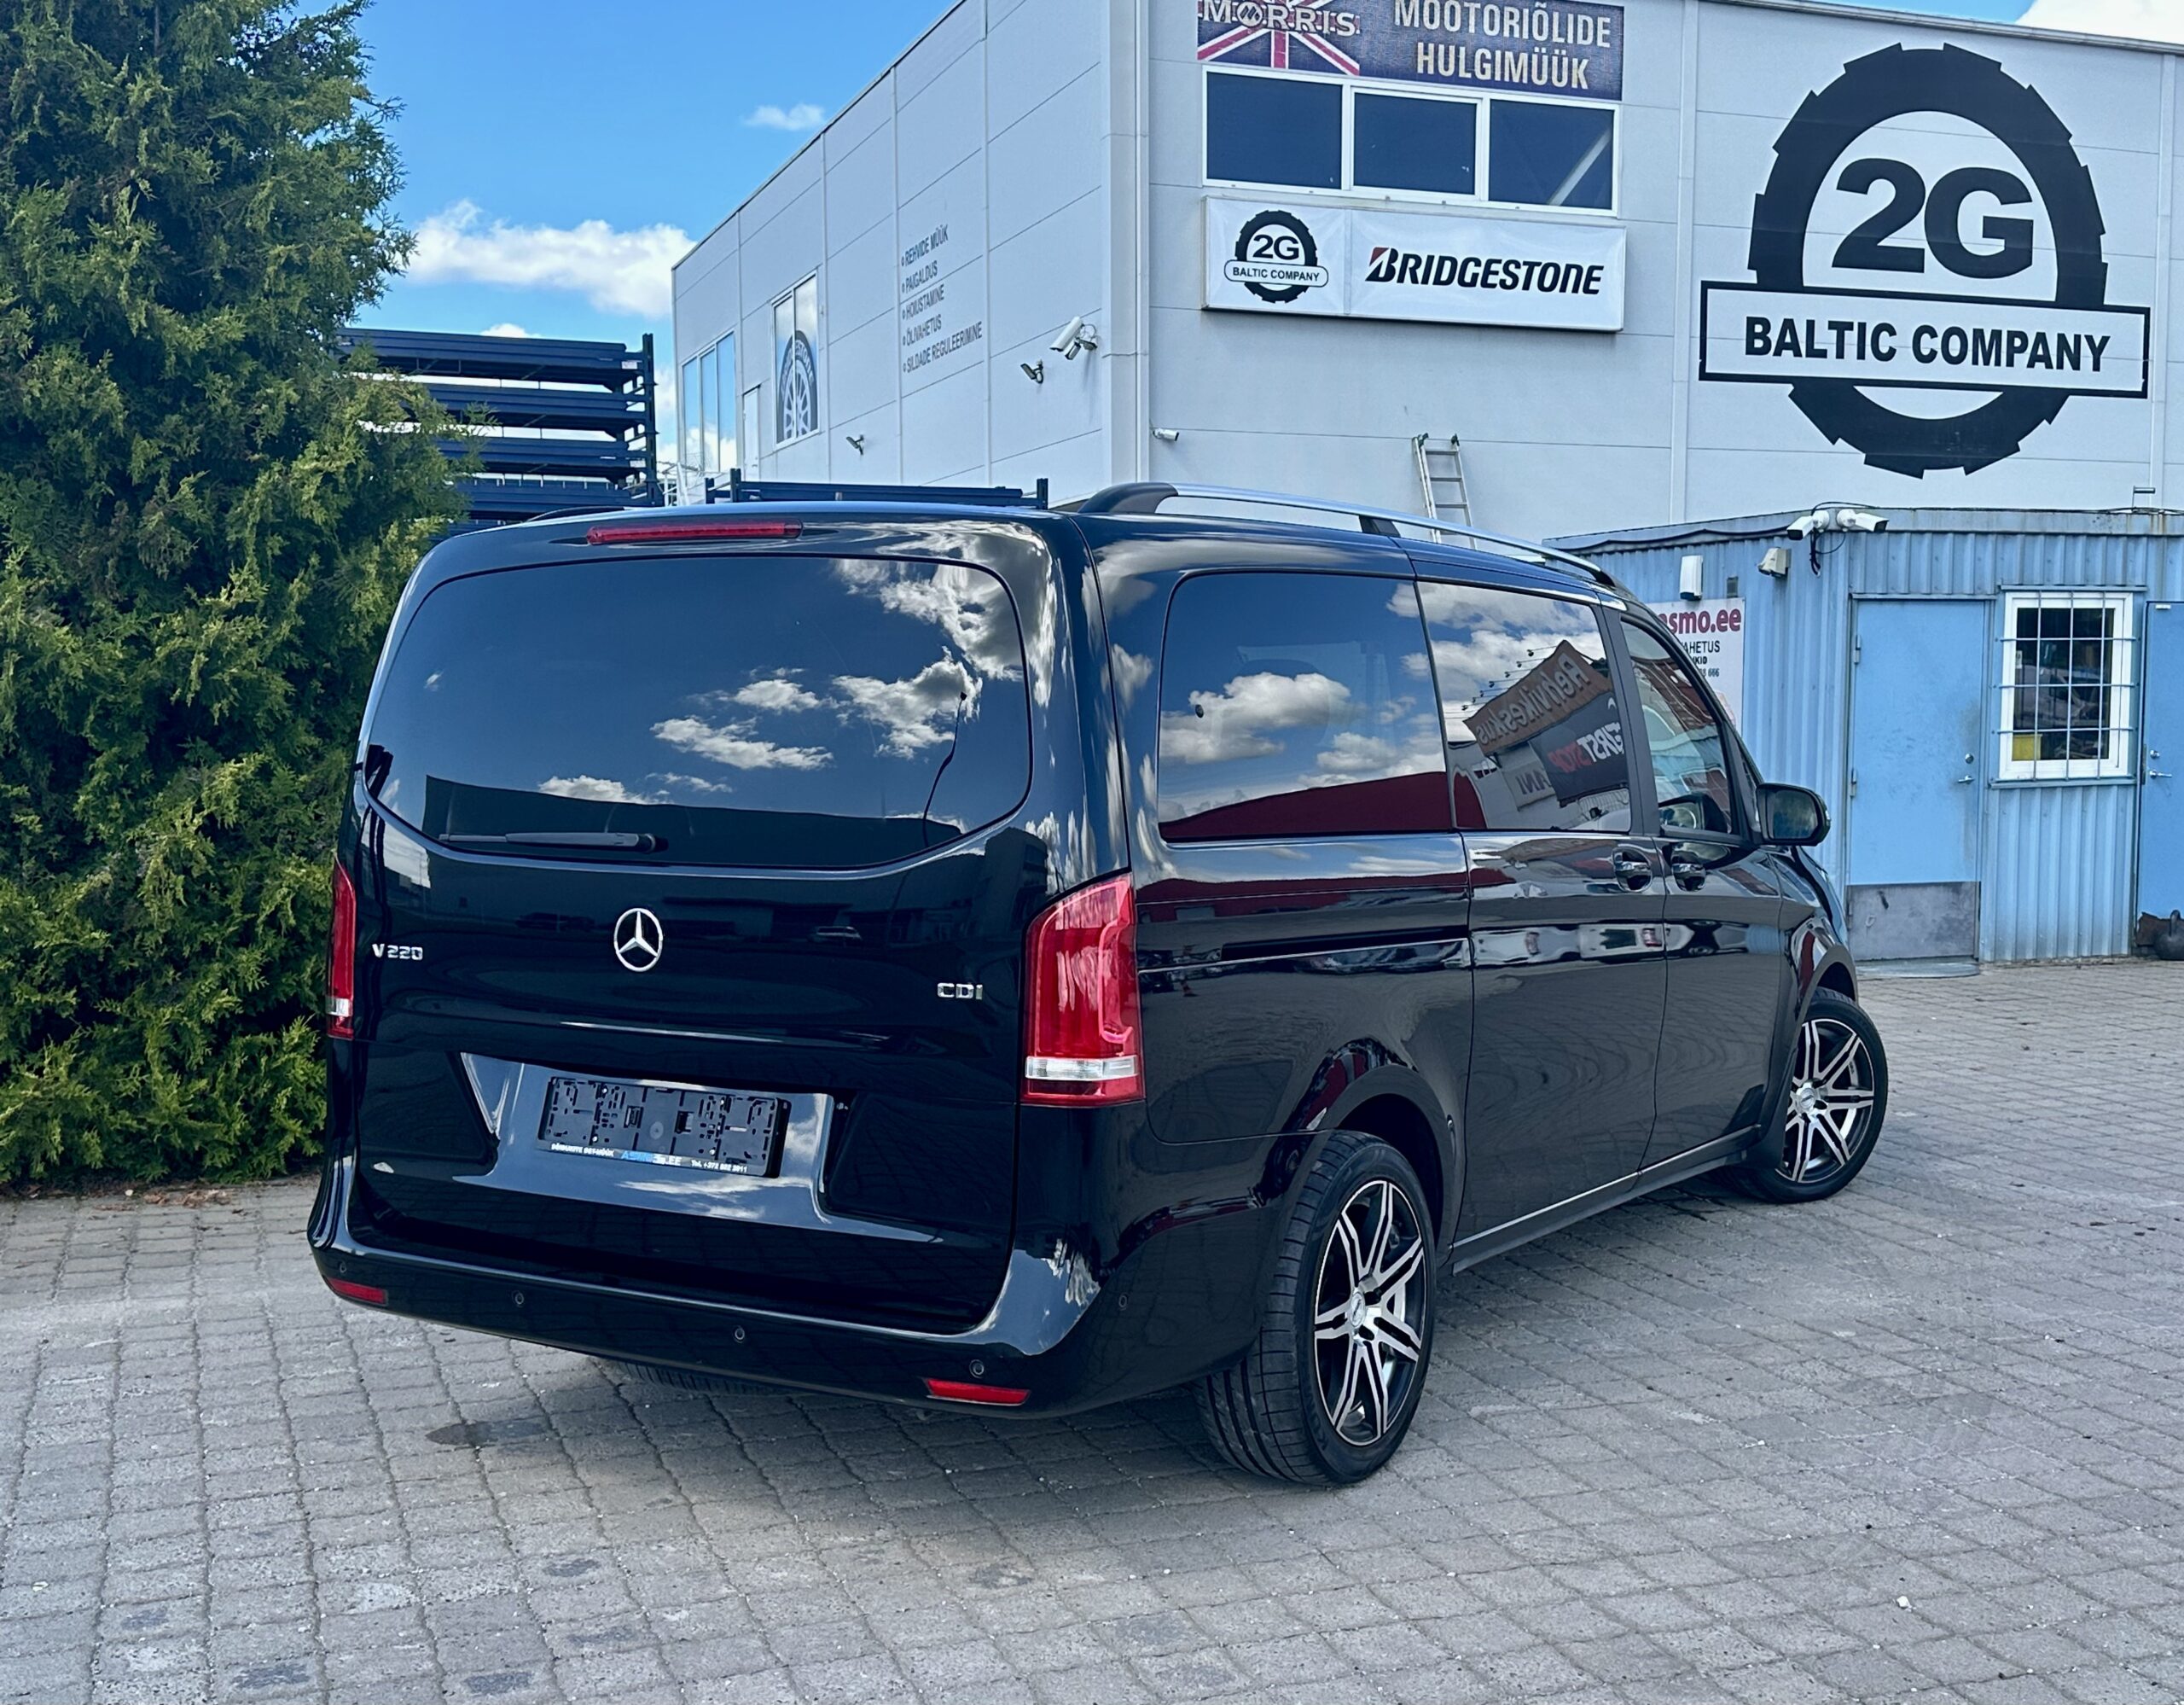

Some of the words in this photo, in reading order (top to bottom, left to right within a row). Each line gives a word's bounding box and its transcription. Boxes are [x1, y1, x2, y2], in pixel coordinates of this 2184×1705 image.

[1202, 0, 1356, 37] MORRIS
[1394, 0, 1612, 48] MOOTORIÕLIDE
[1417, 42, 1589, 90] HULGIMÜÜK
[1832, 157, 2034, 279] 2G
[930, 224, 949, 251] MÜÜK
[1252, 234, 1299, 260] 2G
[906, 259, 938, 294] PAIGALDUS
[1233, 267, 1269, 278] BALTIC
[1270, 270, 1320, 282] COMPANY
[1365, 247, 1605, 295] BRIDGESTONE
[1745, 316, 1896, 362] BALTIC
[1912, 323, 2111, 372] COMPANY
[1682, 640, 1721, 654] AHETUS
[387, 945, 423, 961] 220
[937, 982, 983, 1000] CDI
